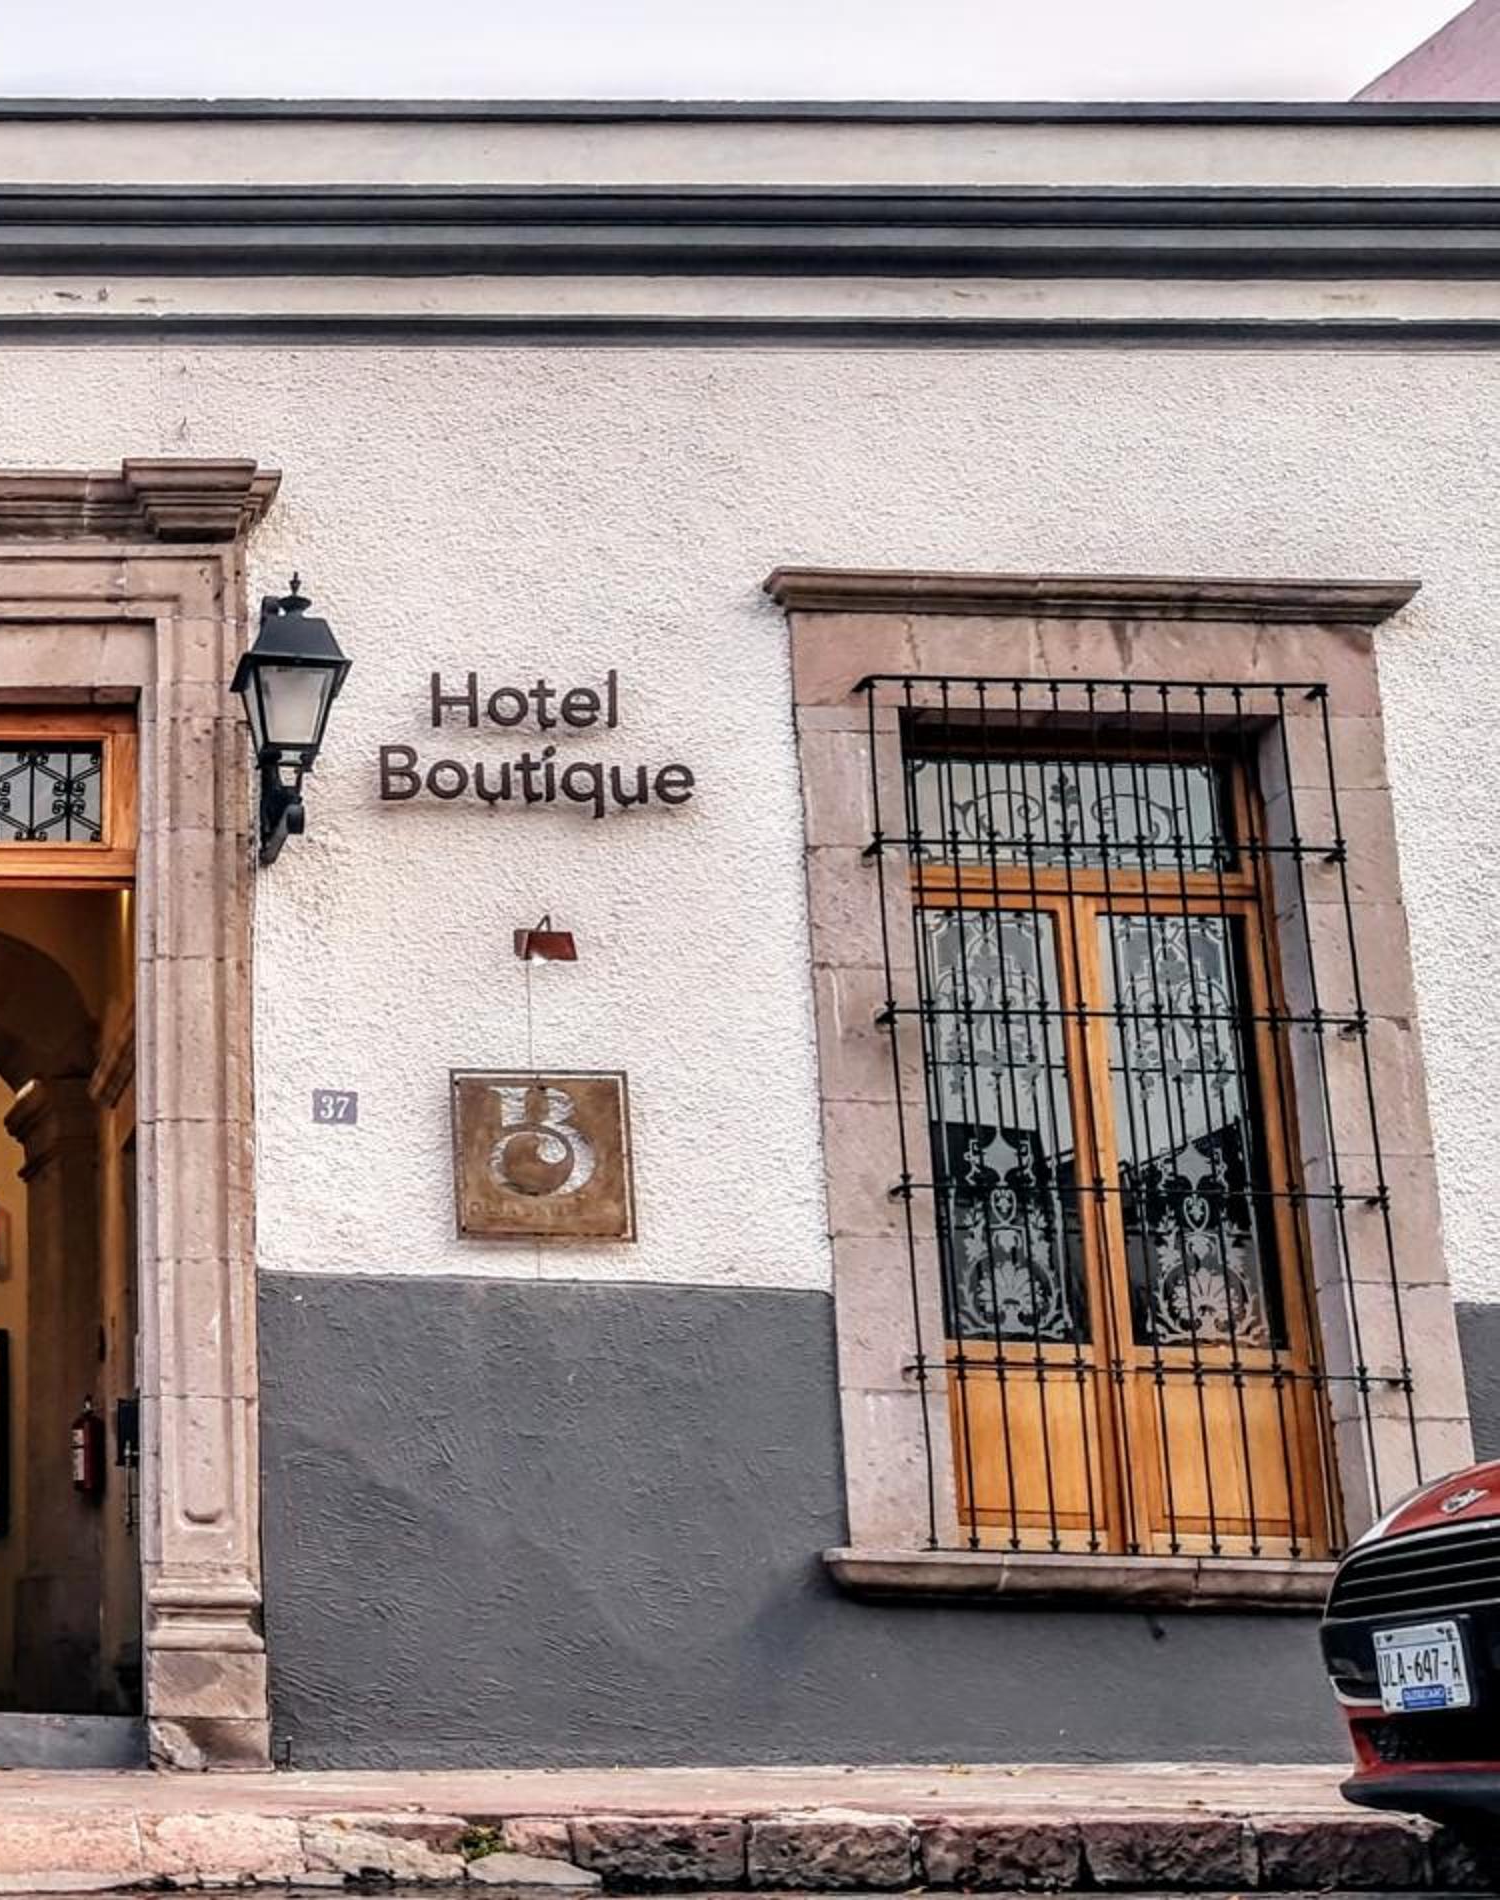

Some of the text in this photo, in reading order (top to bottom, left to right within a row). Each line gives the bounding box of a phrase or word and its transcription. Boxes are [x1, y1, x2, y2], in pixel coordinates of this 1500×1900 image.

[430, 669, 618, 730] Hotel
[379, 745, 695, 819] Boutique
[319, 1095, 350, 1119] 37
[1378, 1644, 1462, 1688] ULA-647-A
